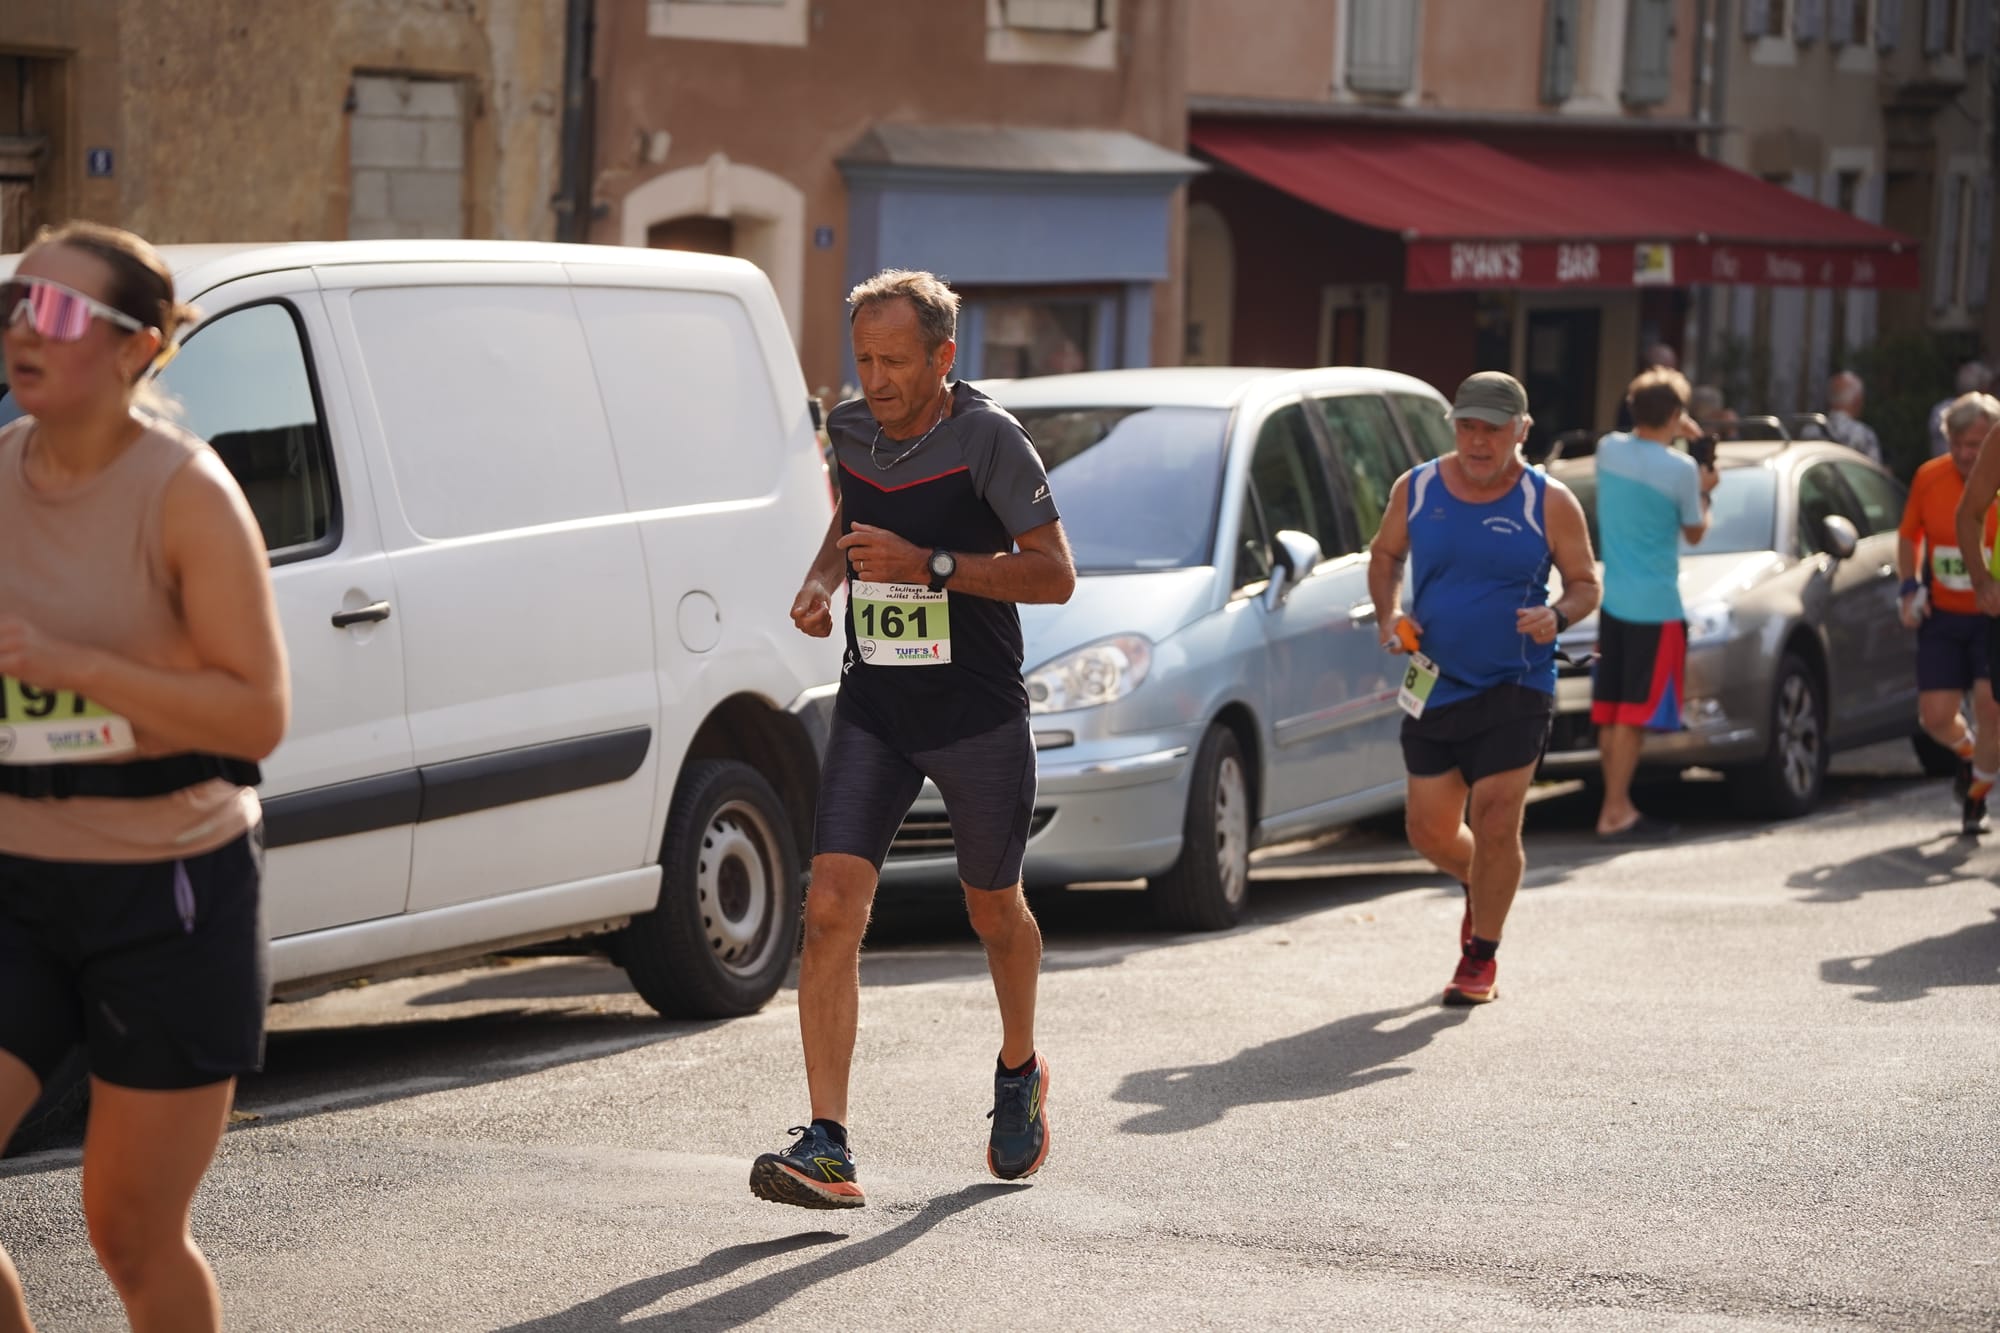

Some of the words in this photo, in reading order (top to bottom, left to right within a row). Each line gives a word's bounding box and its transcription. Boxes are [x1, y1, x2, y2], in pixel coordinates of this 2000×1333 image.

[1556, 243, 1599, 279] BAR
[889, 585, 923, 595] Challenge
[861, 603, 928, 638] 161
[895, 647, 929, 655] TUFF'S
